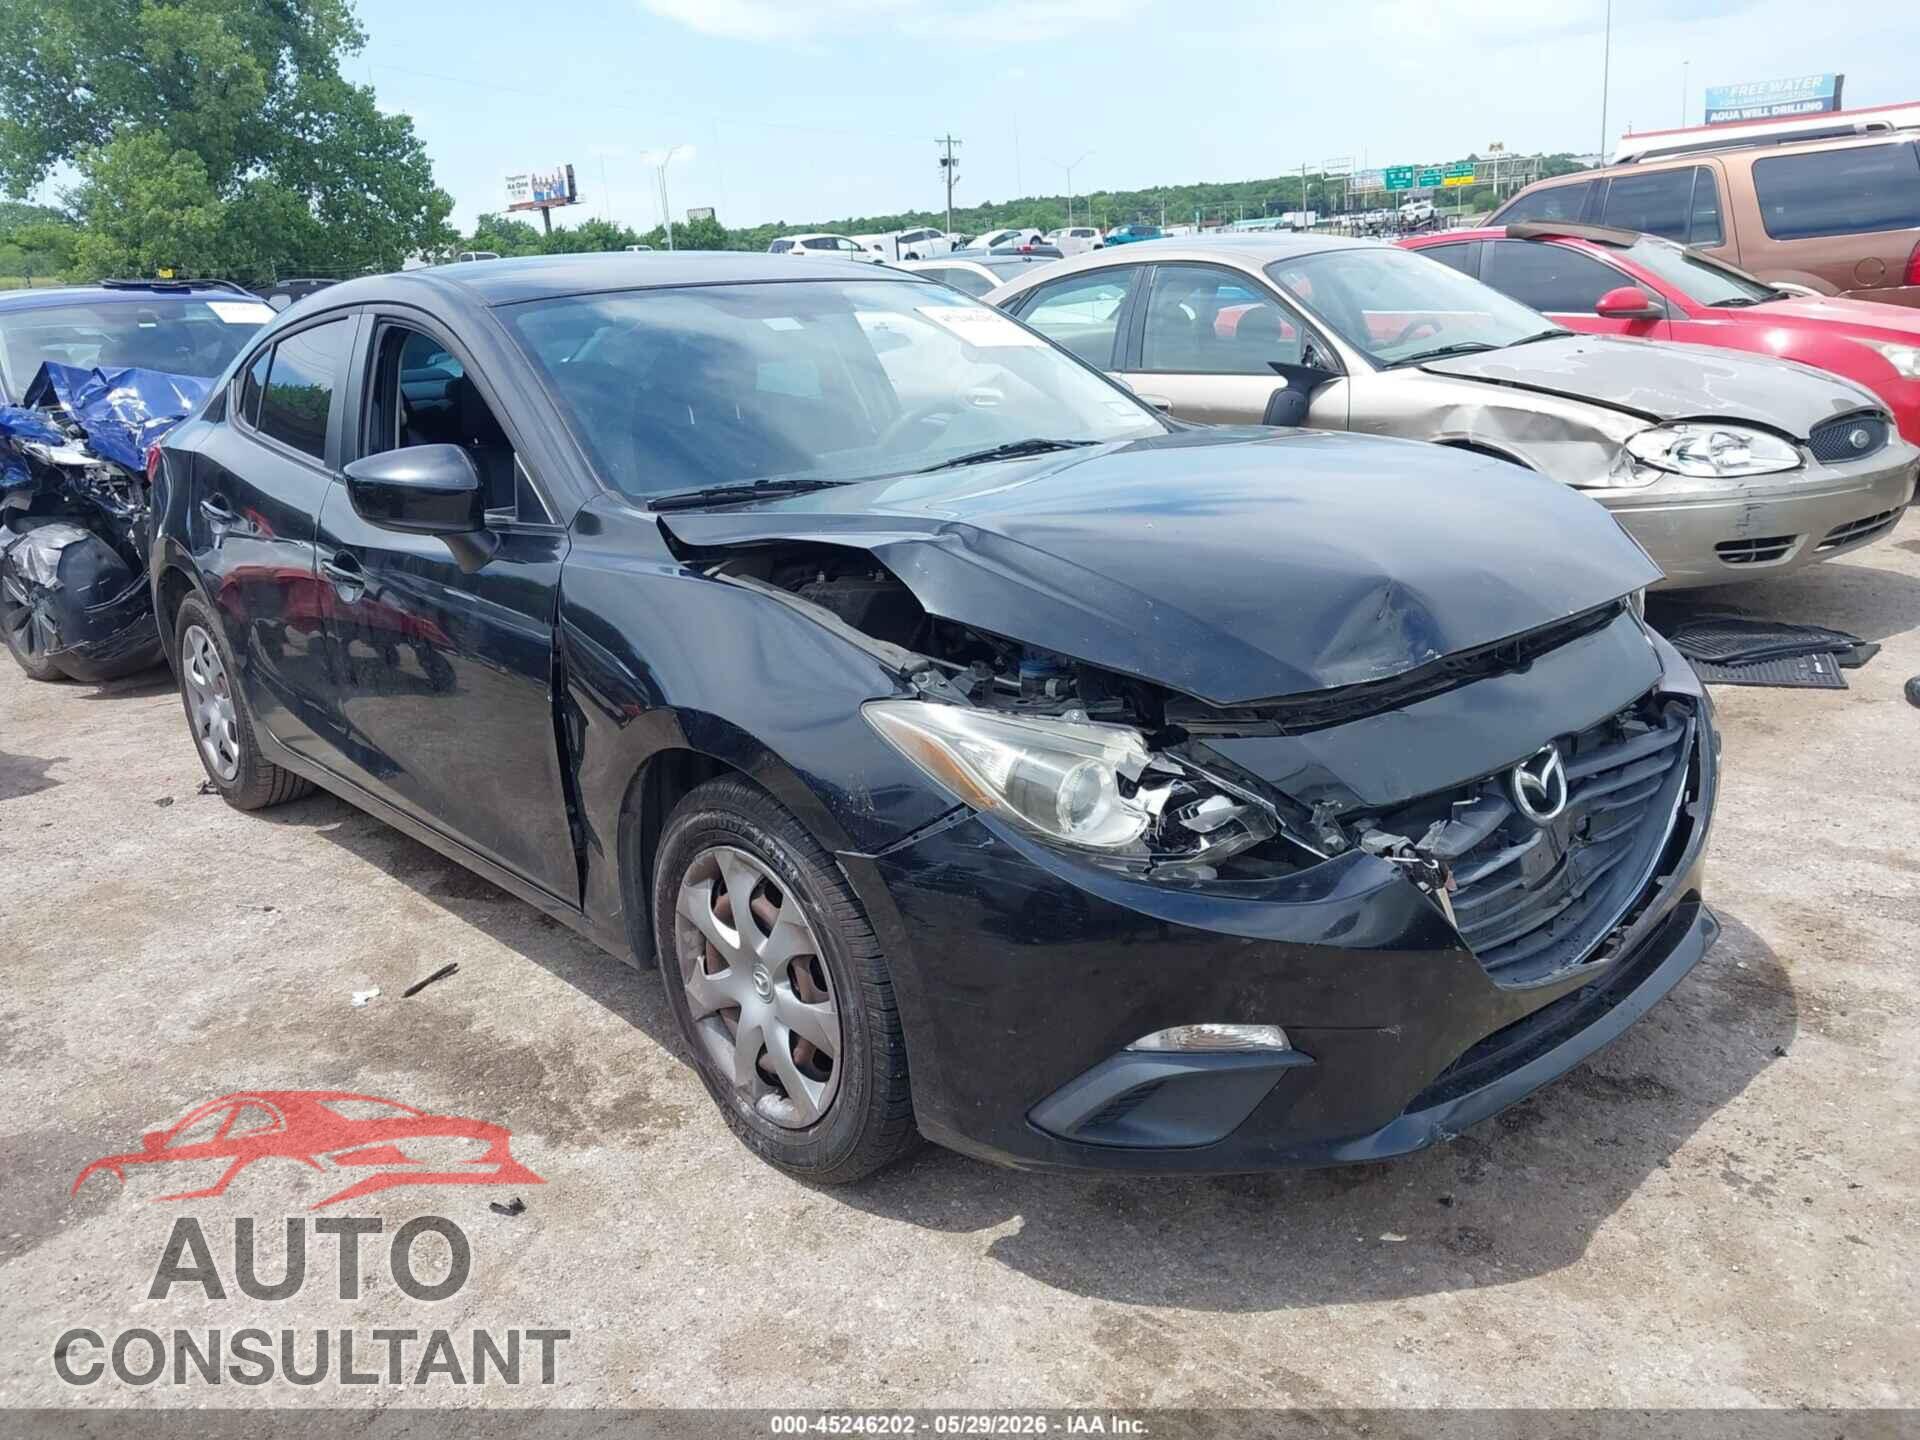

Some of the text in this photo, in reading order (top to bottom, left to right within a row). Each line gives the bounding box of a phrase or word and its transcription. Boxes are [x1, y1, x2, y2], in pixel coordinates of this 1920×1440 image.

[1728, 83, 1764, 97] FREE
[1768, 75, 1823, 92] WATER
[1710, 101, 1823, 122] AQUA WELL DRILLING
